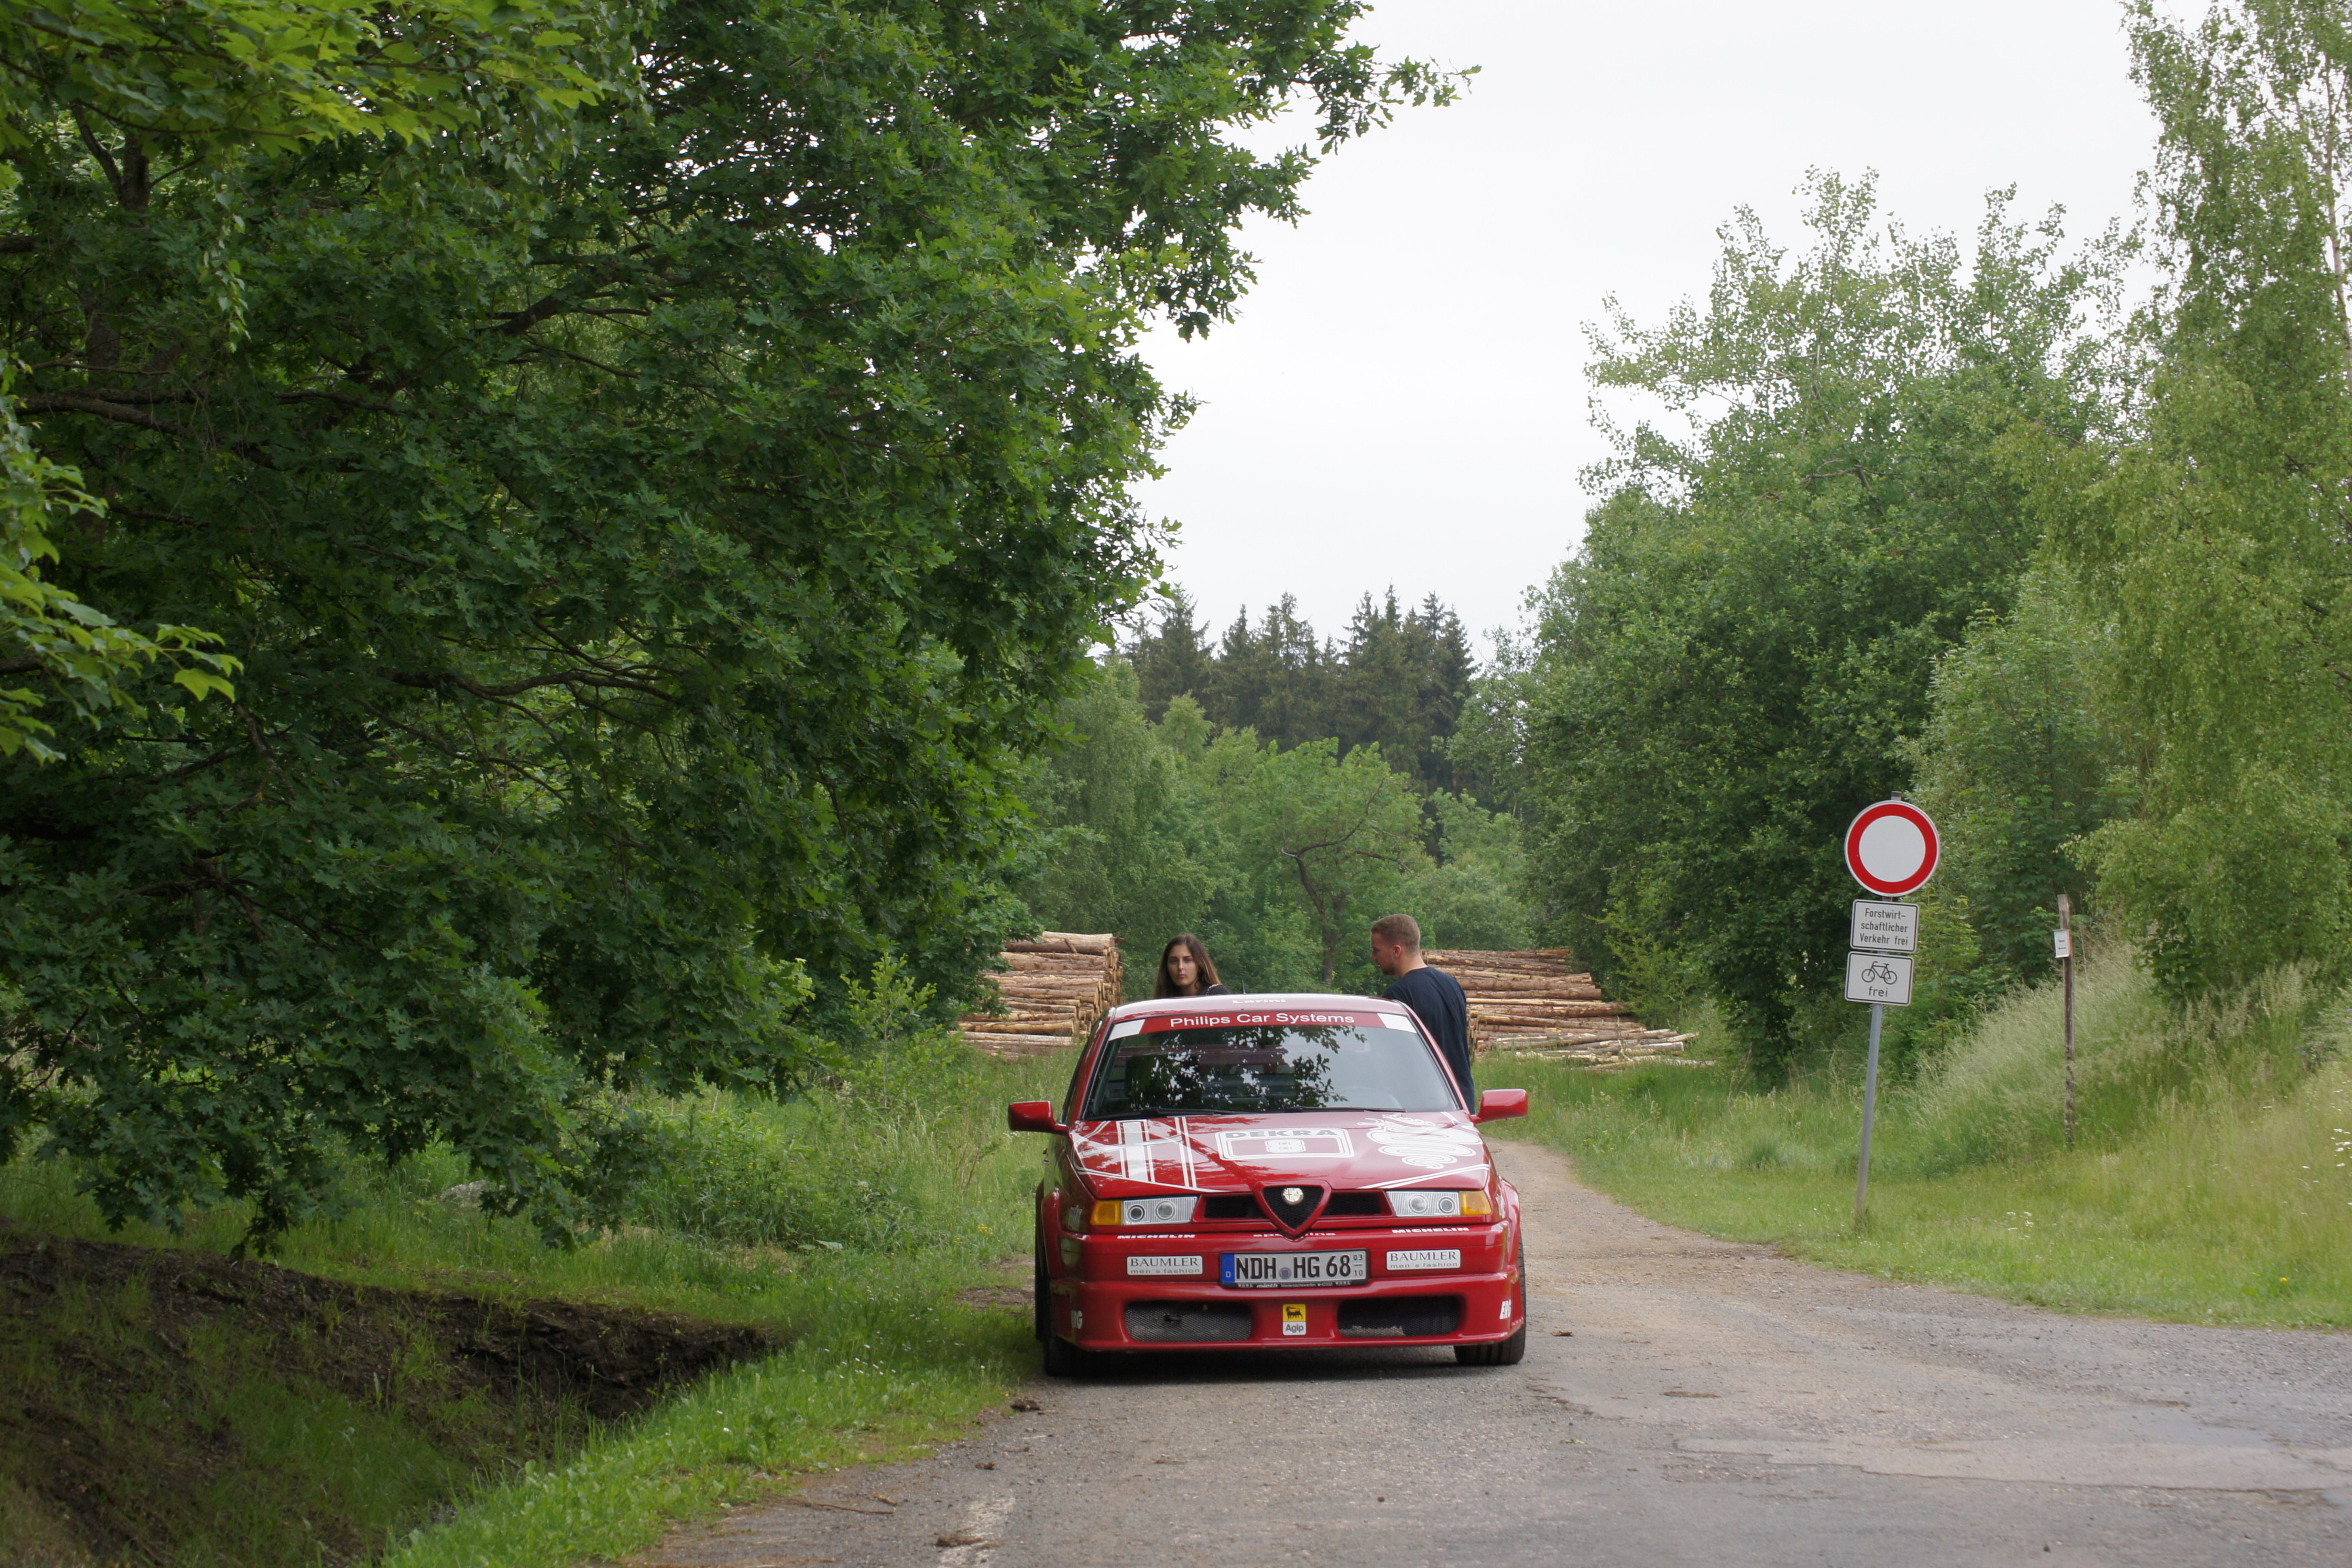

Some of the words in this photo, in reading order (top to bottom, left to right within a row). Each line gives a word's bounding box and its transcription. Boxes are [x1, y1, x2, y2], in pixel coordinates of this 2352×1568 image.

[1865, 908, 1906, 920] Forstwirt-
[1860, 921, 1908, 932] schaftlicher
[1859, 932, 1890, 944] Verkehr
[1895, 936, 1909, 945] frei
[1868, 986, 1888, 997] frei
[1170, 1016, 1231, 1027] Philips
[1237, 1014, 1270, 1024] Car
[1276, 1012, 1355, 1024] Systems
[1225, 1130, 1338, 1138] DEKRA
[1236, 1257, 1277, 1279] NDH
[1294, 1256, 1320, 1278] HG
[1326, 1255, 1351, 1277] 68
[1285, 1323, 1304, 1333] Agip
